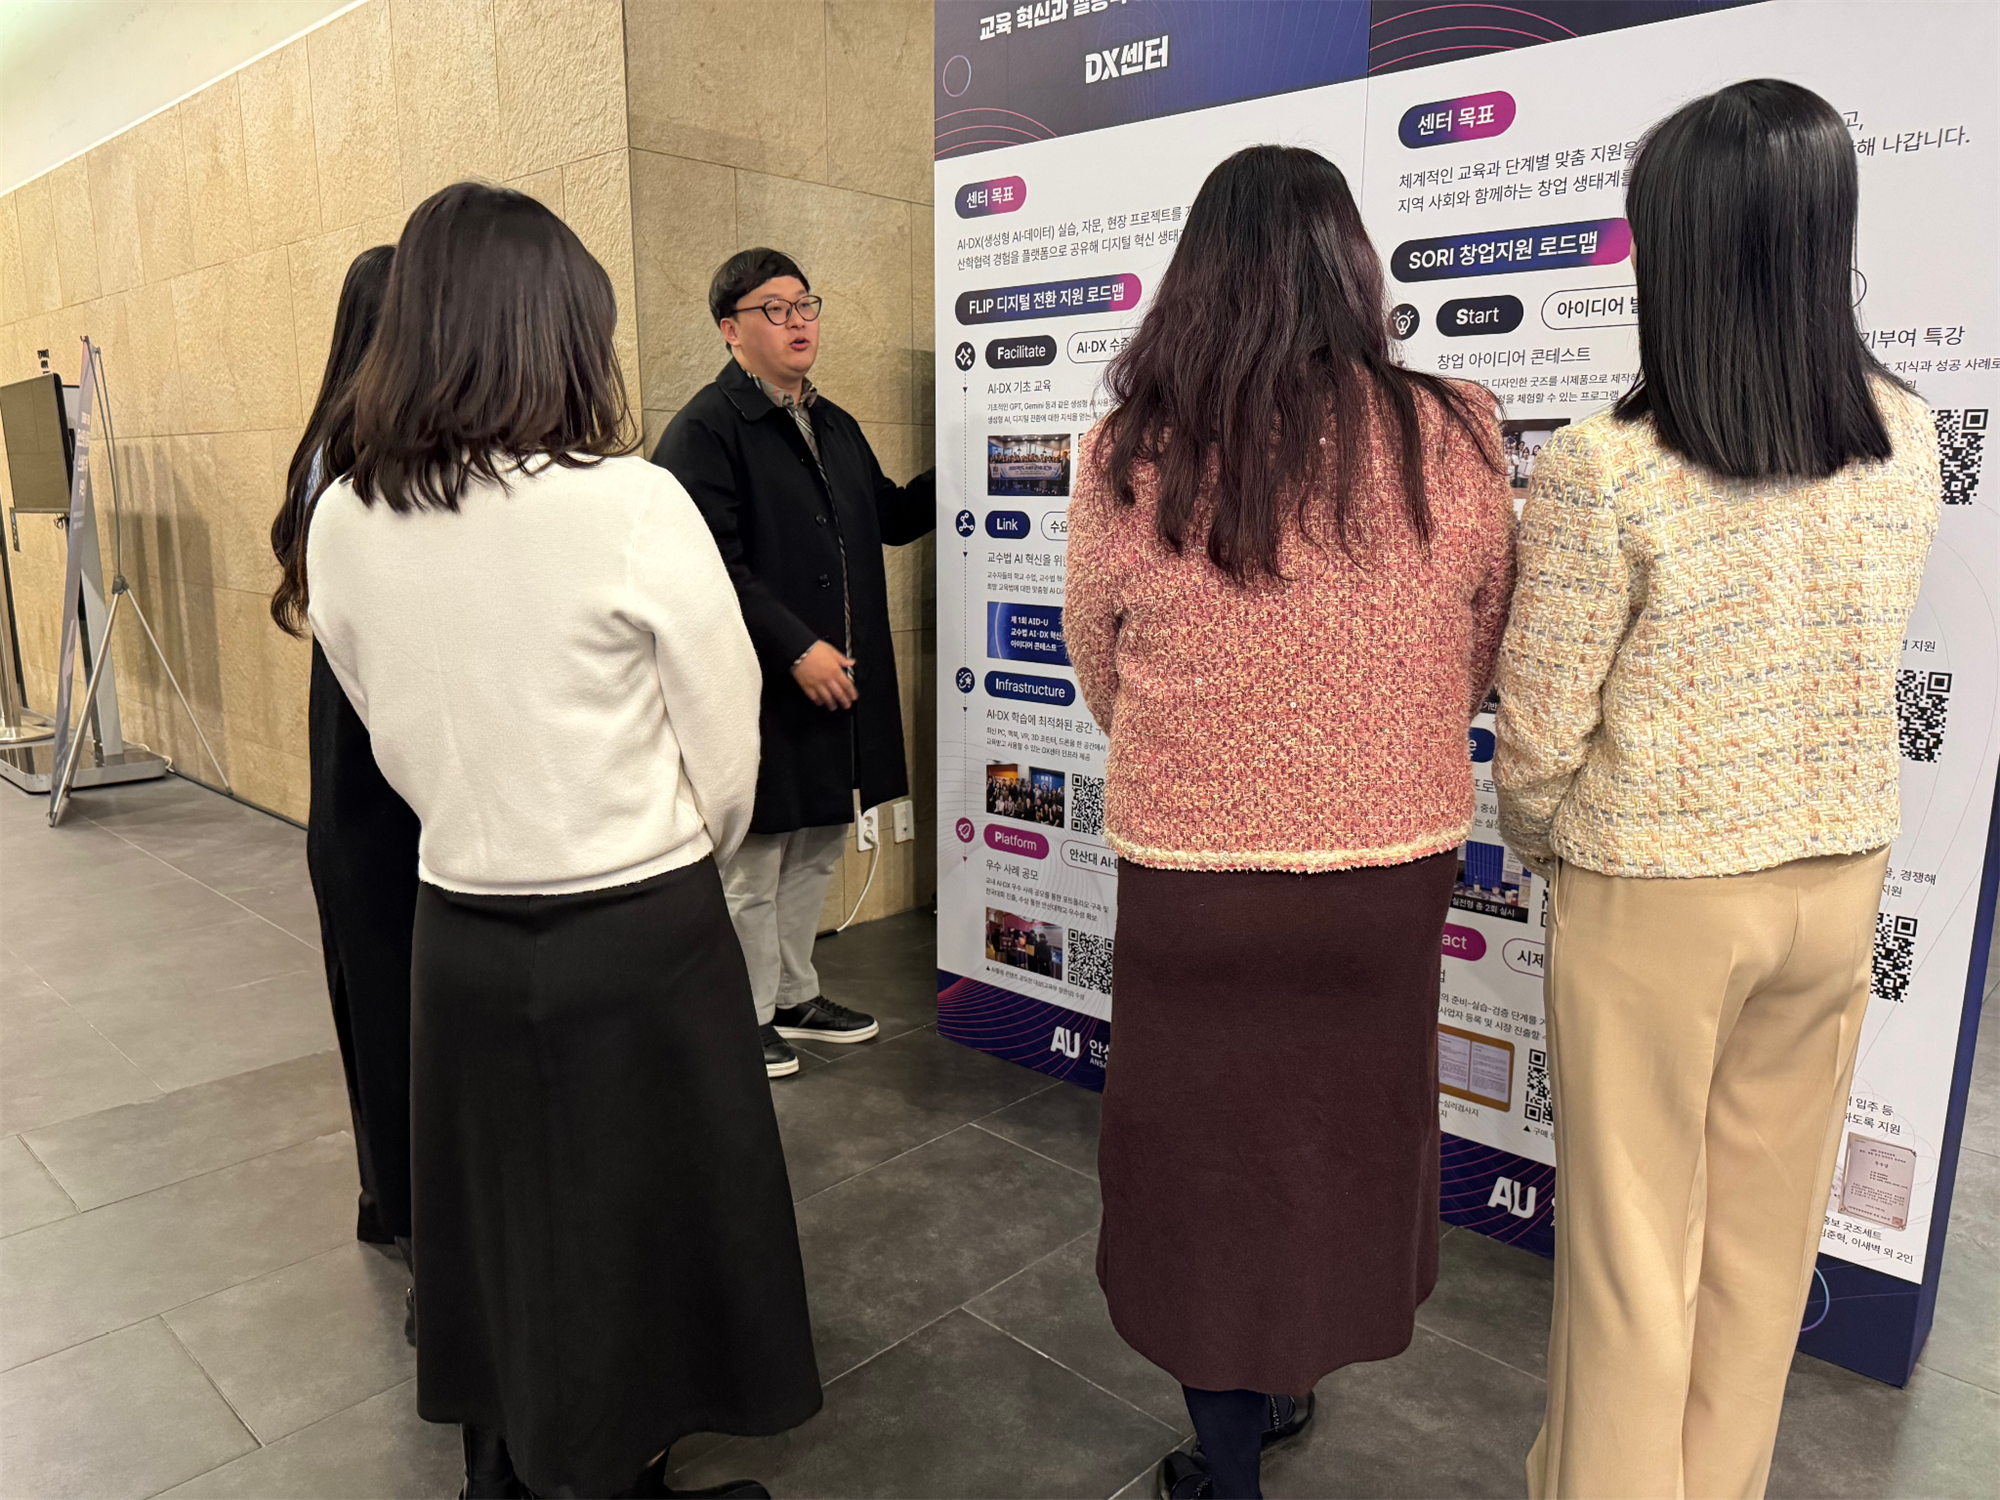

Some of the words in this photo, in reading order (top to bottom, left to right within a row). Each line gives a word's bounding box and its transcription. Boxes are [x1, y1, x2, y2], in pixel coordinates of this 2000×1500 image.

[980, 11, 1012, 41] 교육
[1017, 1, 1068, 29] 혁신과
[1085, 35, 1168, 84] DX센터
[1417, 110, 1452, 136] 센터
[1458, 104, 1494, 129] 목표
[1398, 196, 1424, 213] 지역
[1429, 190, 1470, 209] 사회와
[1475, 182, 1533, 205] 함께하는
[1538, 177, 1567, 197] 창업
[1882, 126, 1970, 153] 나갑니다.
[1399, 167, 1453, 190] 체계적인
[1458, 160, 1500, 181] 교육과
[1505, 152, 1549, 176] 단계별
[1555, 149, 1585, 168] 맞춤
[1590, 141, 1637, 162] 지원을
[967, 189, 988, 209] 센터
[992, 186, 1014, 205] 목표
[1058, 223, 1079, 238] 실습,
[1082, 220, 1104, 234] 자문,
[1107, 215, 1126, 229] 현장
[1130, 206, 1181, 227] 프로젝트를
[957, 254, 990, 271] 산학협력
[993, 249, 1019, 266] 경험을
[1022, 244, 1067, 263] 플랫폼으로
[1070, 240, 1098, 256] 공유해
[1102, 237, 1130, 251] 디지털
[1134, 234, 1154, 247] 혁신
[1409, 248, 1453, 270] SORI
[1459, 238, 1532, 266] 창업지원
[1538, 231, 1597, 257] 로드맵
[969, 298, 993, 315] FLIP
[997, 294, 1030, 313] 디지털
[1034, 290, 1056, 308] 전환
[1060, 288, 1083, 306] 지원
[1087, 282, 1124, 302] 로드맵
[1558, 297, 1623, 319] 아이디어
[1456, 308, 1499, 325] Start
[1923, 326, 1965, 346] 특강
[997, 345, 1045, 360] Facilitate
[1437, 353, 1464, 370] 창업
[1469, 350, 1525, 368] 아이디어
[1531, 347, 1590, 365] 콘테스트
[1895, 360, 1932, 373] 지식과
[1936, 359, 1961, 371] 성공
[1014, 381, 1031, 394] 기초
[1034, 380, 1051, 392] 교육
[1492, 377, 1528, 389] 디자인한
[1530, 375, 1558, 387] 굿즈를
[1560, 374, 1607, 386] 시제품으로
[1025, 402, 1044, 410] Gemini
[1517, 393, 1544, 404] 체험할
[1547, 394, 1555, 403] 수
[1559, 392, 1577, 402] 있는
[1580, 390, 1619, 400] 프로그램
[1048, 413, 1059, 422] 대한
[997, 518, 1018, 530] Link
[988, 552, 1012, 564] 교수법
[1014, 555, 1023, 564] AI
[1025, 554, 1051, 566] 혁신을
[1011, 628, 1027, 637] 교수법
[1011, 640, 1032, 650] 아이디어
[1034, 643, 1057, 651] 콘테스트
[1912, 640, 1935, 652] 지원
[996, 678, 1065, 698] Infrastructure
[1011, 712, 1035, 725] 학습에
[1039, 716, 1072, 731] 최적화된
[1075, 721, 1092, 734] 공간
[995, 832, 1036, 851] Platform
[1069, 848, 1097, 866] 안산대
[986, 860, 1001, 871] 우수
[1004, 864, 1020, 876] 사례
[1022, 868, 1038, 880] 공모
[1900, 870, 1936, 885] 경쟁해
[1485, 904, 1497, 914] 2회
[1500, 908, 1514, 917] 실시
[1466, 1013, 1481, 1024] 등록
[1495, 1021, 1511, 1032] 시장
[1514, 1026, 1539, 1040] 진출할
[1511, 1011, 1537, 1025] 단계를
[1050, 1026, 1080, 1059] AU
[1856, 1098, 1878, 1111] 입주
[1882, 1105, 1893, 1116] 등
[1533, 1127, 1548, 1138] 구매
[1878, 1120, 1900, 1135] 지원
[1487, 1177, 1537, 1219] AU
[1843, 1221, 1882, 1240] 굿즈세트
[1852, 1238, 1880, 1254] 이새벽
[1883, 1248, 1893, 1258] 외
[1897, 1252, 1913, 1264] 2인
